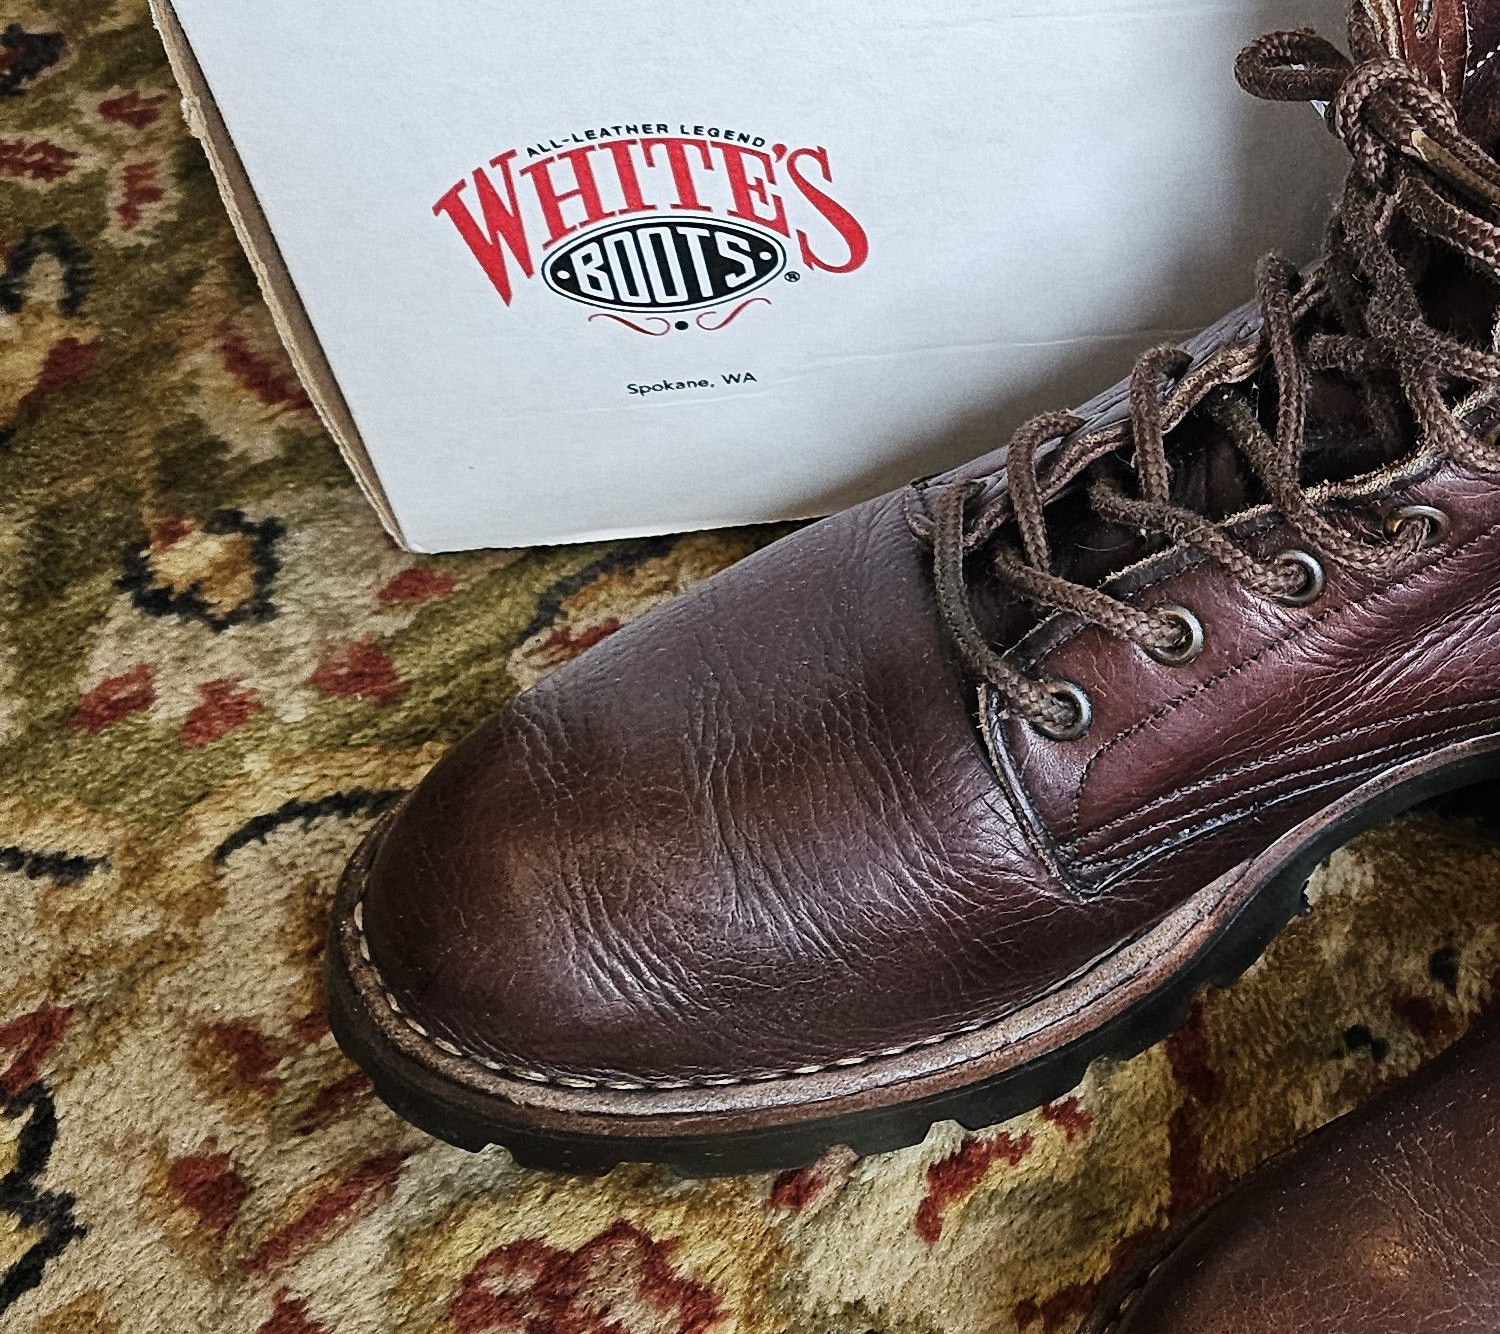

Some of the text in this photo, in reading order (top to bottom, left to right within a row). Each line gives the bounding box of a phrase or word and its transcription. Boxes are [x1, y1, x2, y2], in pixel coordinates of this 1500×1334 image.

[527, 123, 766, 157] ALL-LEATHER LEGEND
[432, 137, 869, 307] WHITE'S
[569, 226, 752, 304] BOOTS
[627, 372, 757, 396] Spokane, WA
